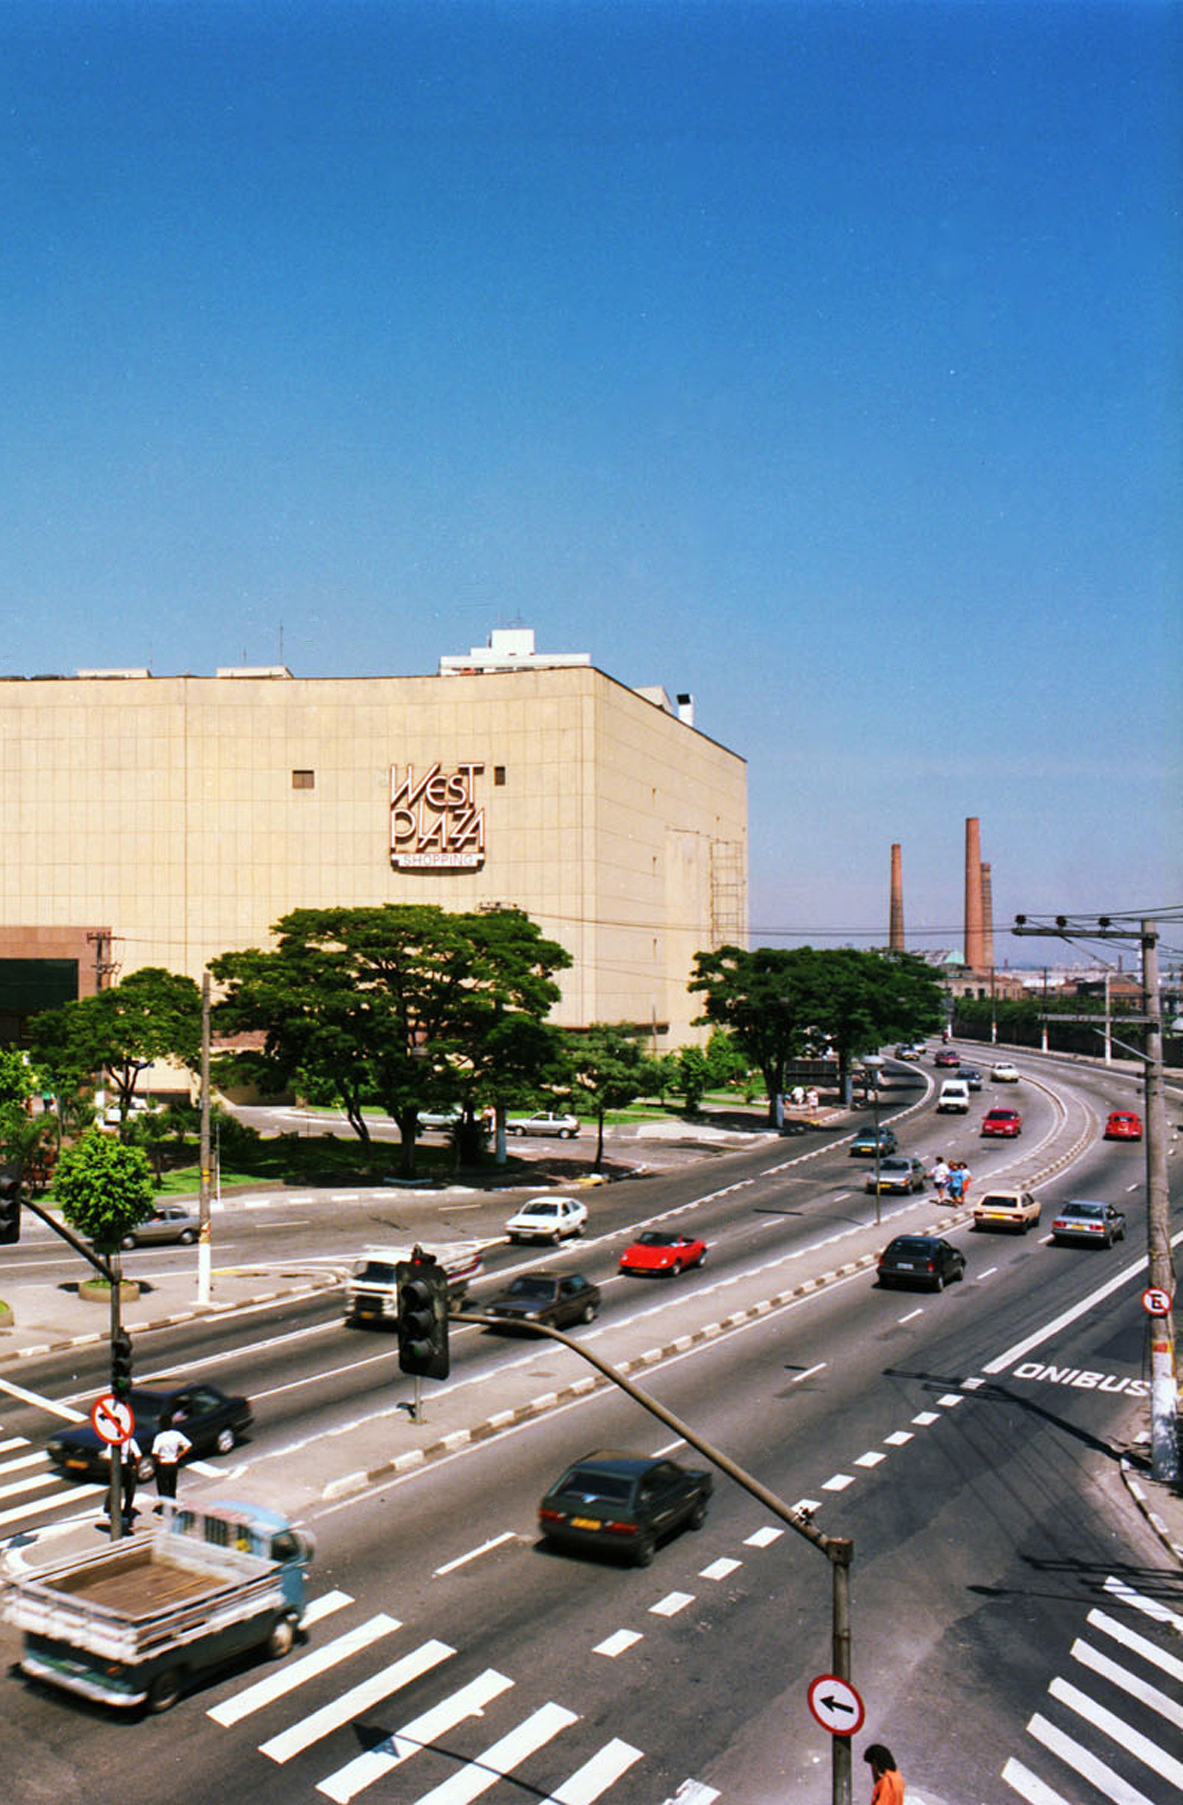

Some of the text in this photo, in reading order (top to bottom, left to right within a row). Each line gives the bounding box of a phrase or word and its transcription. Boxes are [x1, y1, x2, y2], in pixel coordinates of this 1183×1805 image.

[391, 799, 485, 850] PLAZA
[402, 853, 474, 866] SHOPPING
[1150, 1293, 1163, 1310] E
[1012, 1362, 1152, 1397] ONIBUS
